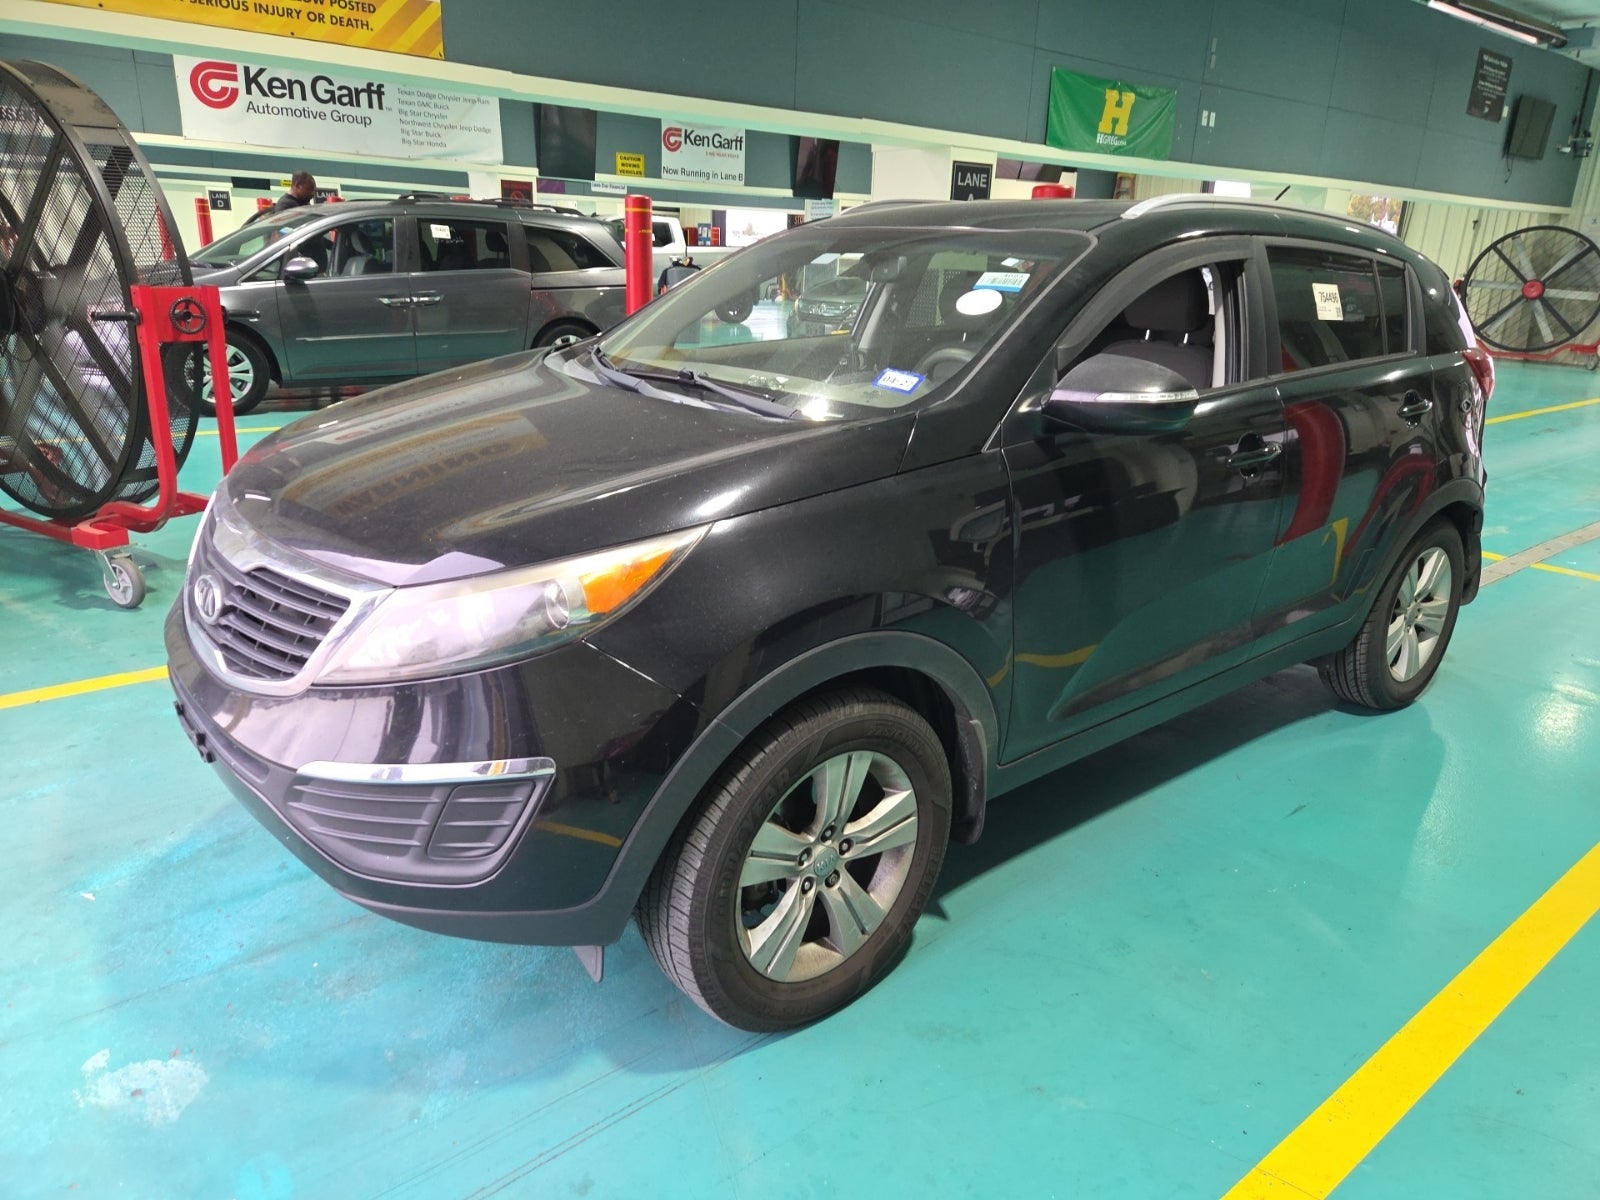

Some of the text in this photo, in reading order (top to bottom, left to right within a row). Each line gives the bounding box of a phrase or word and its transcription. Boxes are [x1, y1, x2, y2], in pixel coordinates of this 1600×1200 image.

[330, 0, 376, 14] POSTED
[254, 2, 302, 20] INJURY
[306, 11, 325, 24] OR
[330, 14, 374, 31] DEATH.
[243, 65, 307, 101] Ken
[310, 74, 386, 111] Garff
[397, 88, 415, 96] Texan
[416, 90, 436, 99] Dodge
[437, 93, 461, 102] Chrysler
[398, 98, 416, 106] Texan
[433, 102, 449, 110] Buick
[246, 101, 372, 128] Automotive Group
[423, 111, 448, 120] Chrysler
[399, 119, 432, 127] Northwest
[433, 122, 458, 130] Chrysler
[400, 128, 410, 136] Big
[425, 130, 442, 138] Buick
[684, 129, 743, 151] Ken Garff
[401, 138, 412, 146] Big
[426, 140, 447, 148] Honda
[662, 166, 744, 181] Now Running in Lane B
[957, 171, 988, 188] LANE
[217, 200, 224, 208] D
